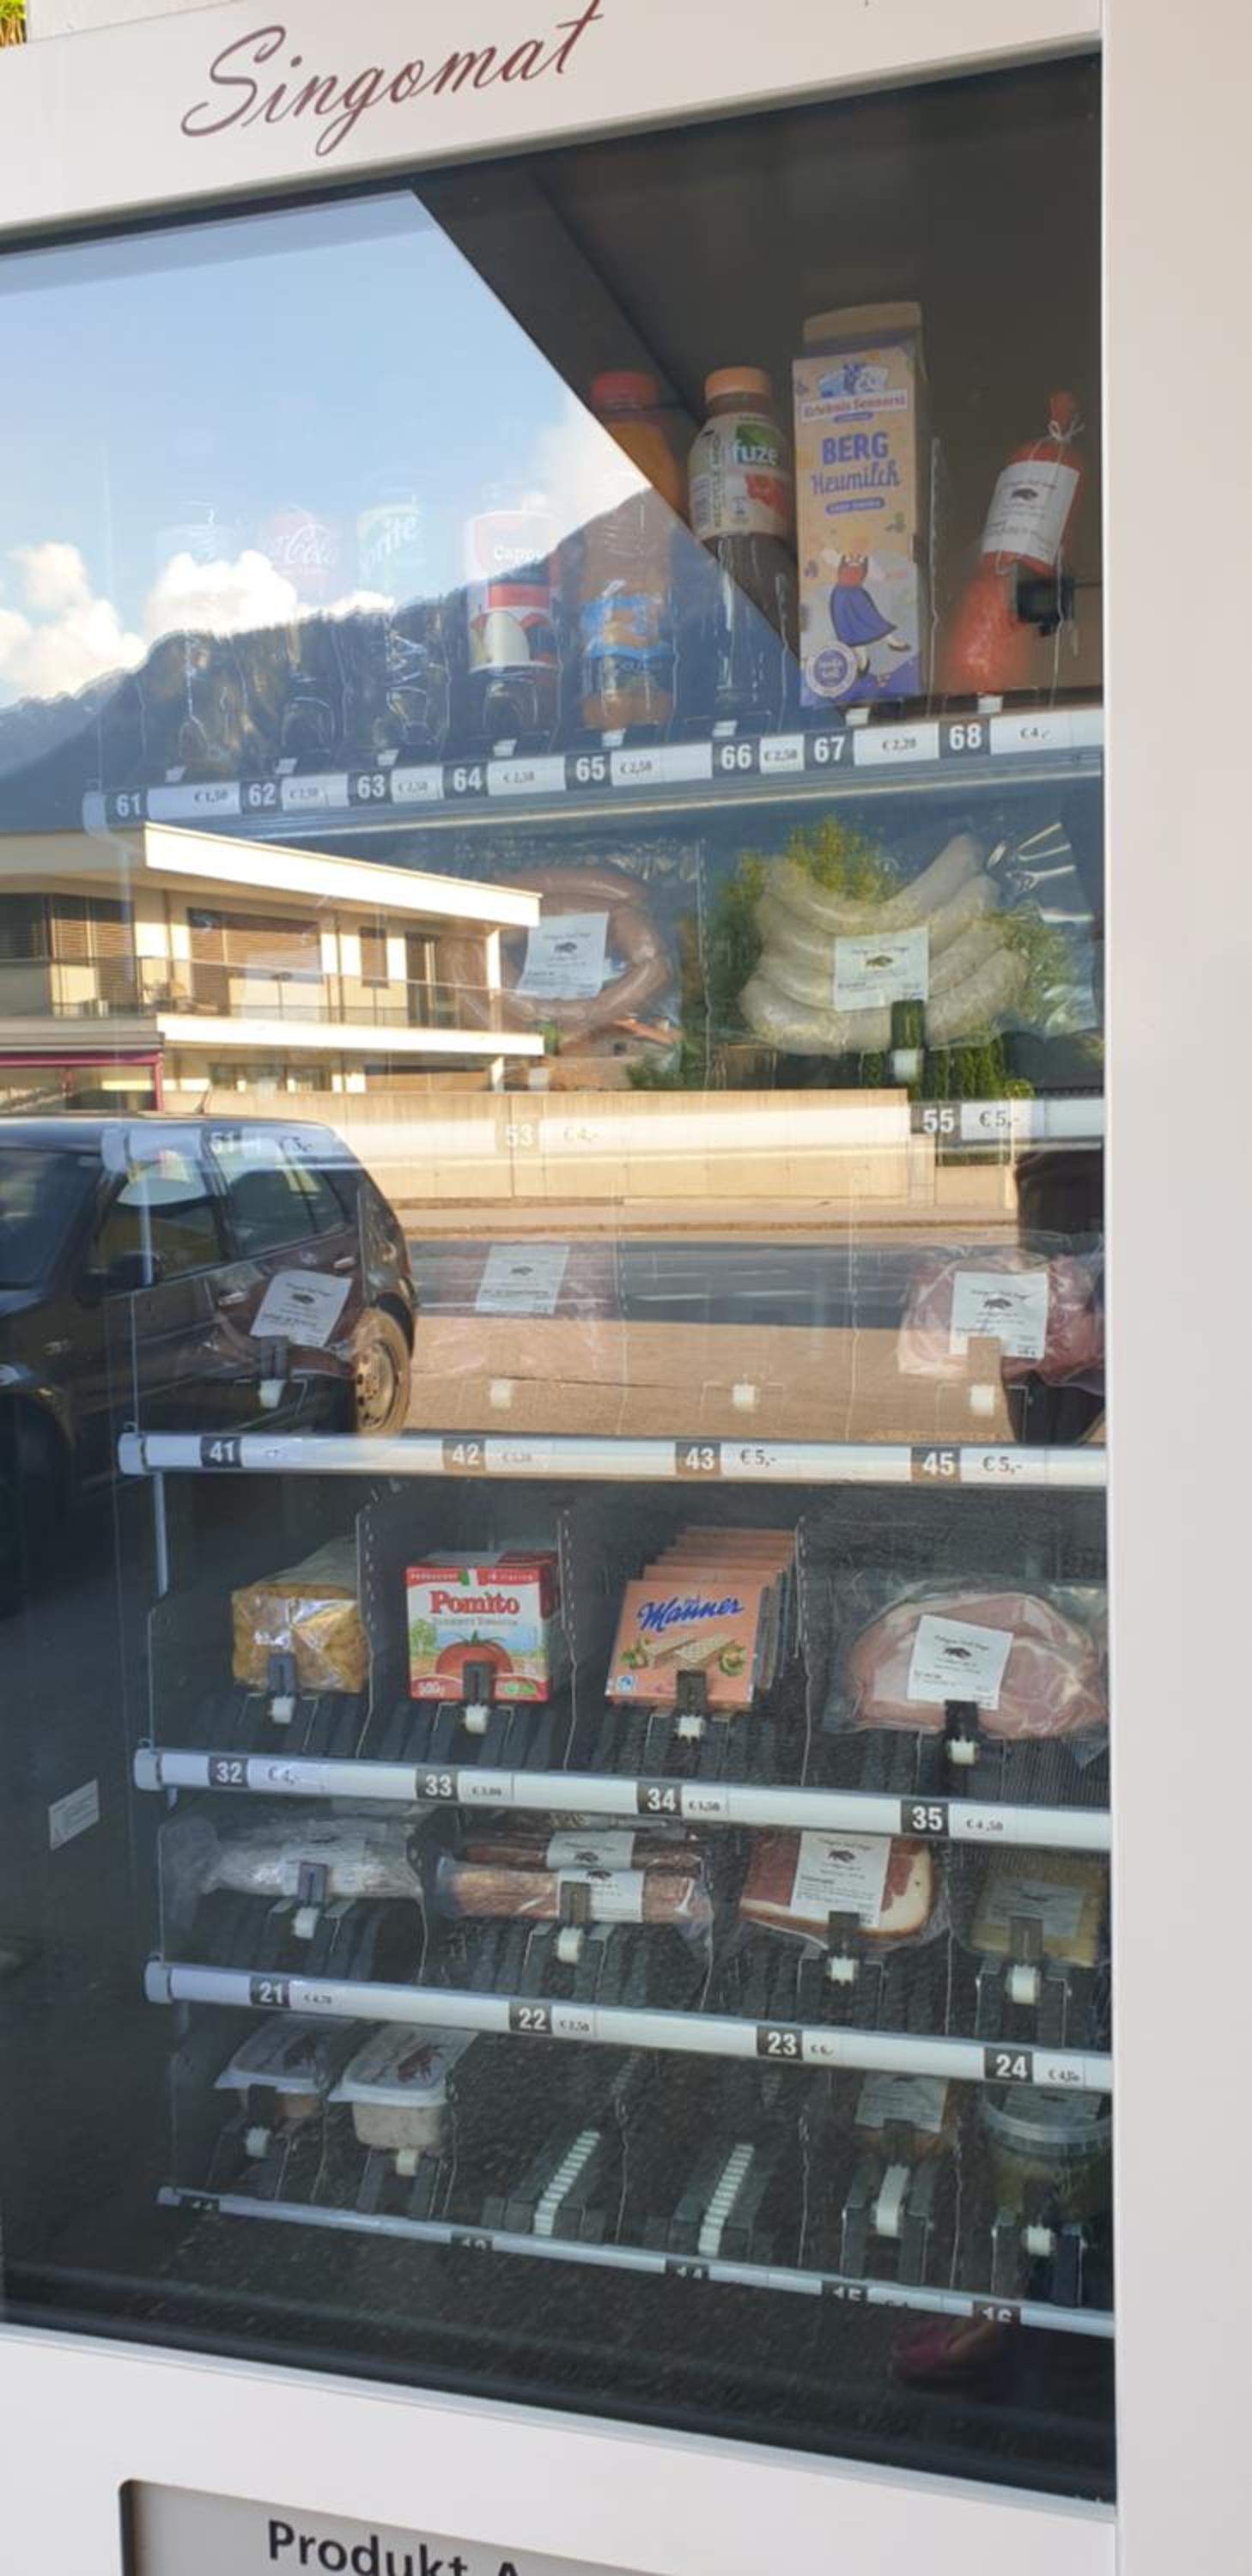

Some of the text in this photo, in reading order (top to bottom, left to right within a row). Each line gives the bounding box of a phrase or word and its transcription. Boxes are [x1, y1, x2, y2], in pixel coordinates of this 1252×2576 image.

[180, 0, 604, 157] Singomat
[822, 431, 890, 465] BERG
[811, 459, 900, 495] Heumilch
[814, 735, 846, 762] 67
[950, 723, 982, 750] 68
[576, 756, 605, 781] 65
[721, 744, 752, 770] 66
[357, 775, 386, 799] 63
[453, 766, 482, 791] 64
[116, 793, 141, 817] 61
[249, 782, 276, 806] 62
[922, 1109, 955, 1133] 55
[506, 1123, 535, 1147] 53
[210, 1441, 235, 1463] 41
[452, 1443, 481, 1466] 42
[686, 1447, 715, 1470] 43
[921, 1452, 955, 1476] 45
[429, 1589, 521, 1615] Pomito
[636, 1595, 745, 1633] Manner
[216, 1761, 243, 1784] 32
[425, 1773, 452, 1797] 33
[647, 1787, 677, 1811] 34
[912, 1806, 943, 1831] 35
[259, 1981, 283, 2003] 21
[519, 2007, 547, 2031] 22
[769, 2031, 798, 2055] 23
[996, 2054, 1027, 2079] 24
[268, 2519, 468, 2576] Produkt
